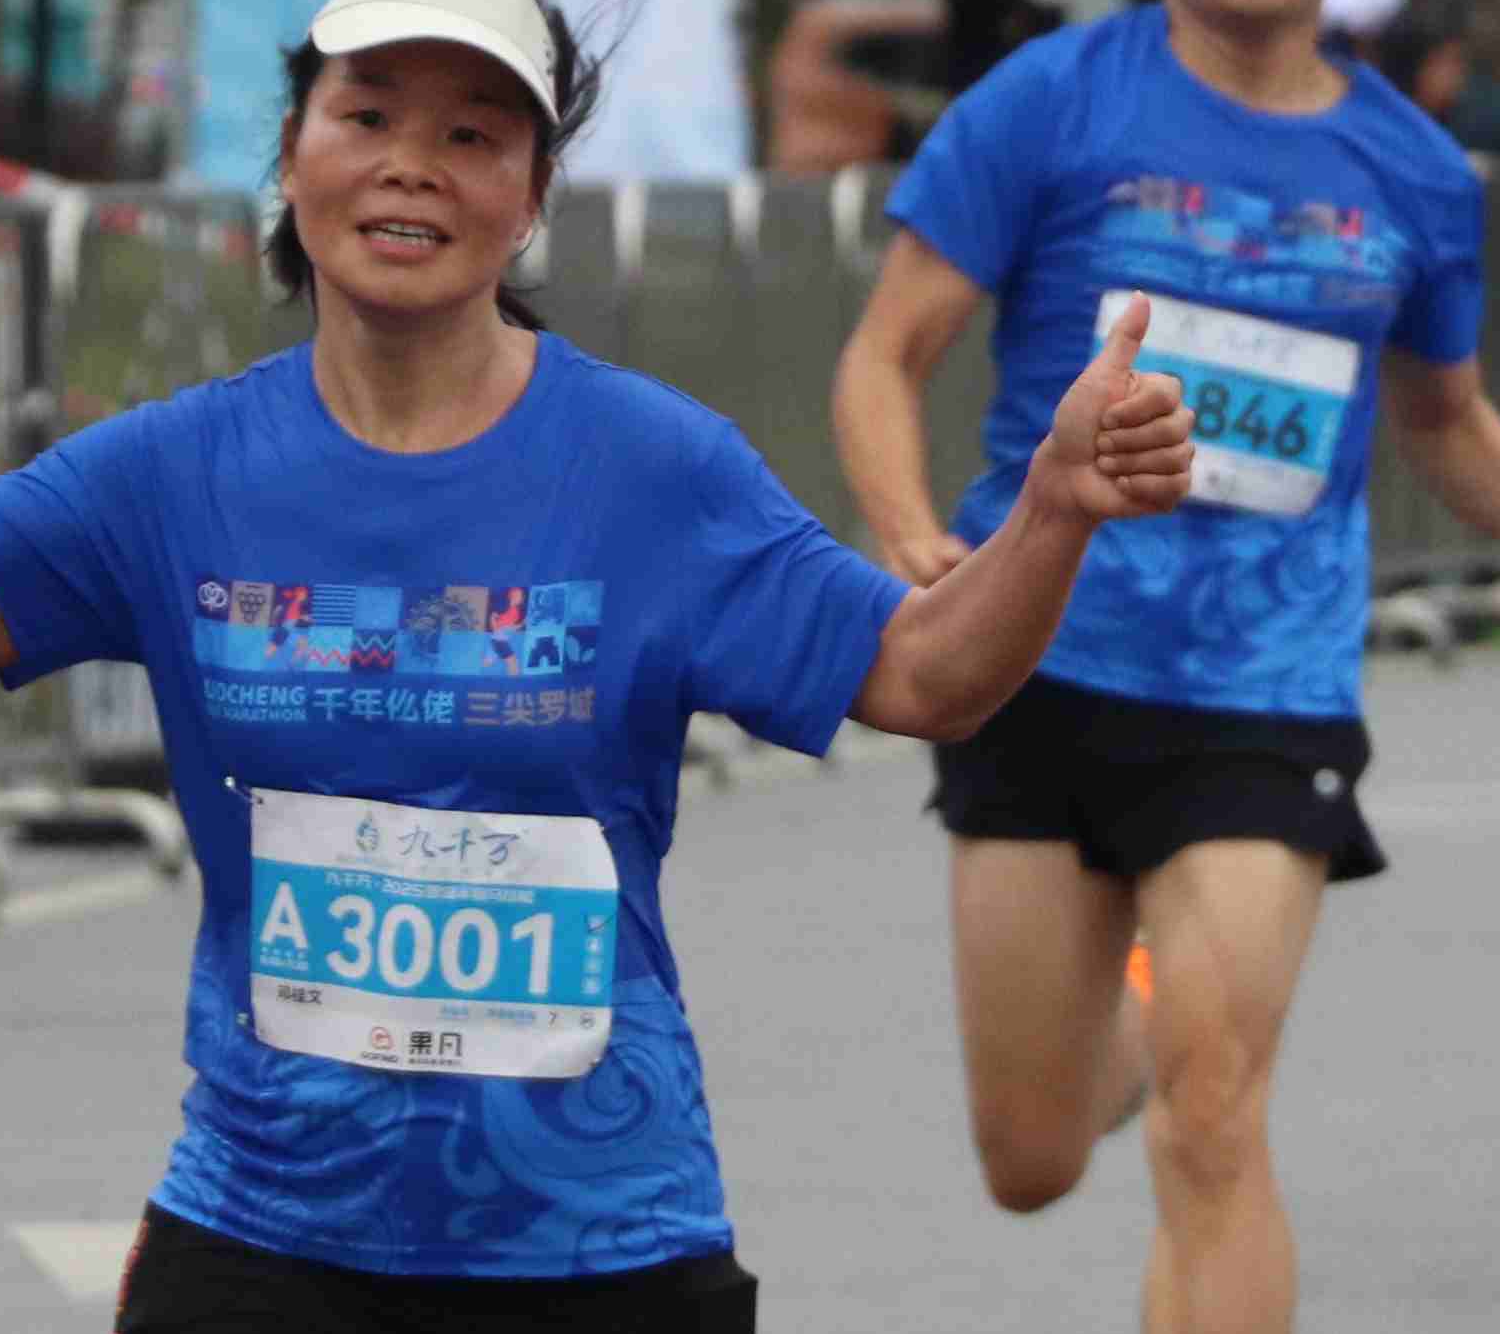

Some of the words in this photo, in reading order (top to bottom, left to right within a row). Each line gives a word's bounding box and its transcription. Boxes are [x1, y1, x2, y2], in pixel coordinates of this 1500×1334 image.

[1172, 373, 1312, 458] 846
[260, 881, 308, 949] A
[326, 894, 554, 996] 3001
